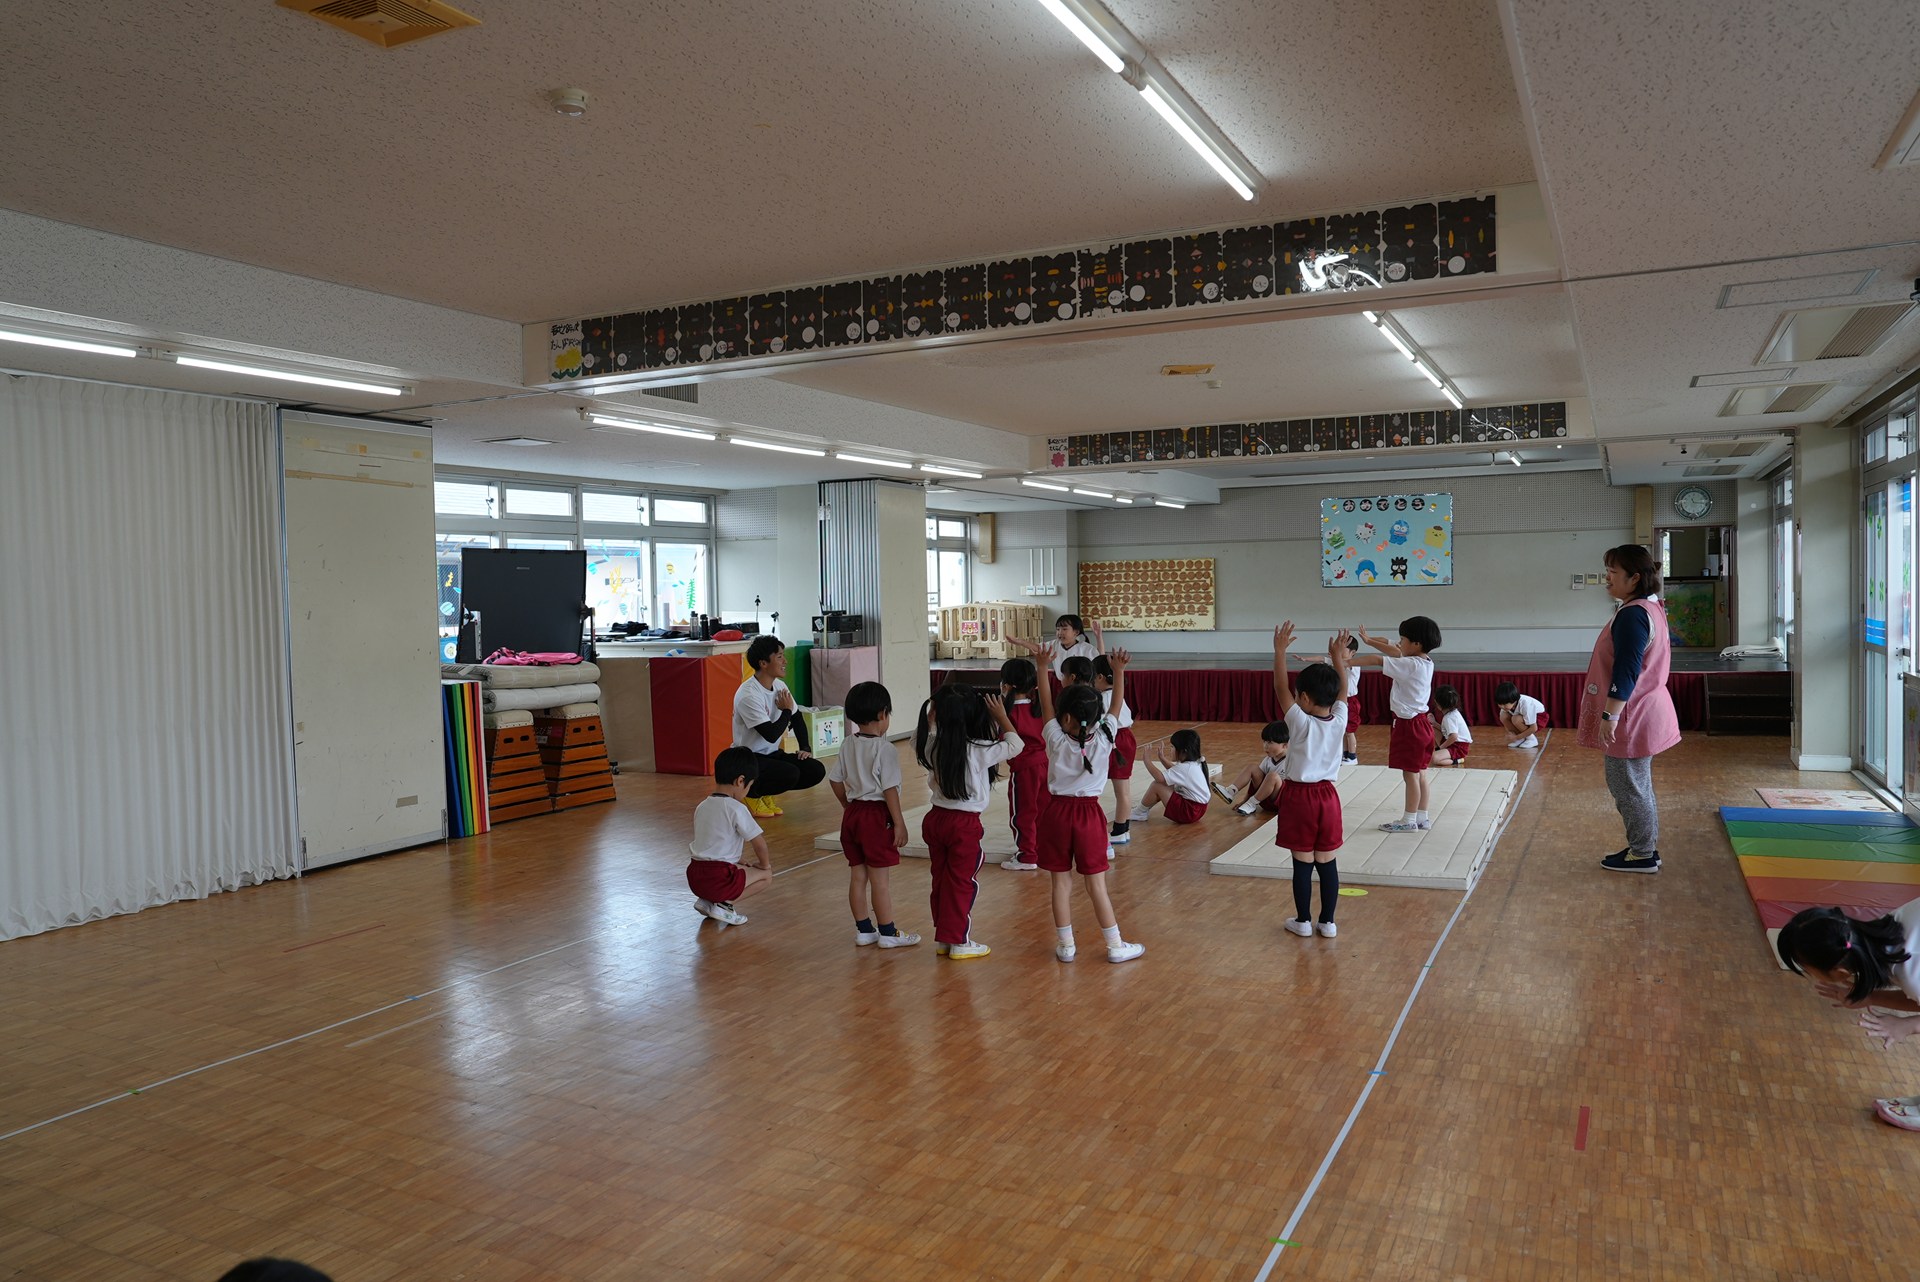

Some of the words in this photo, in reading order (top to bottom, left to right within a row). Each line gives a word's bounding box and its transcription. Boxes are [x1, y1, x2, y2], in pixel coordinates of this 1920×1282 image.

[1344, 498, 1424, 511] おめでとう
[1144, 618, 1197, 629] じぶんのかお
